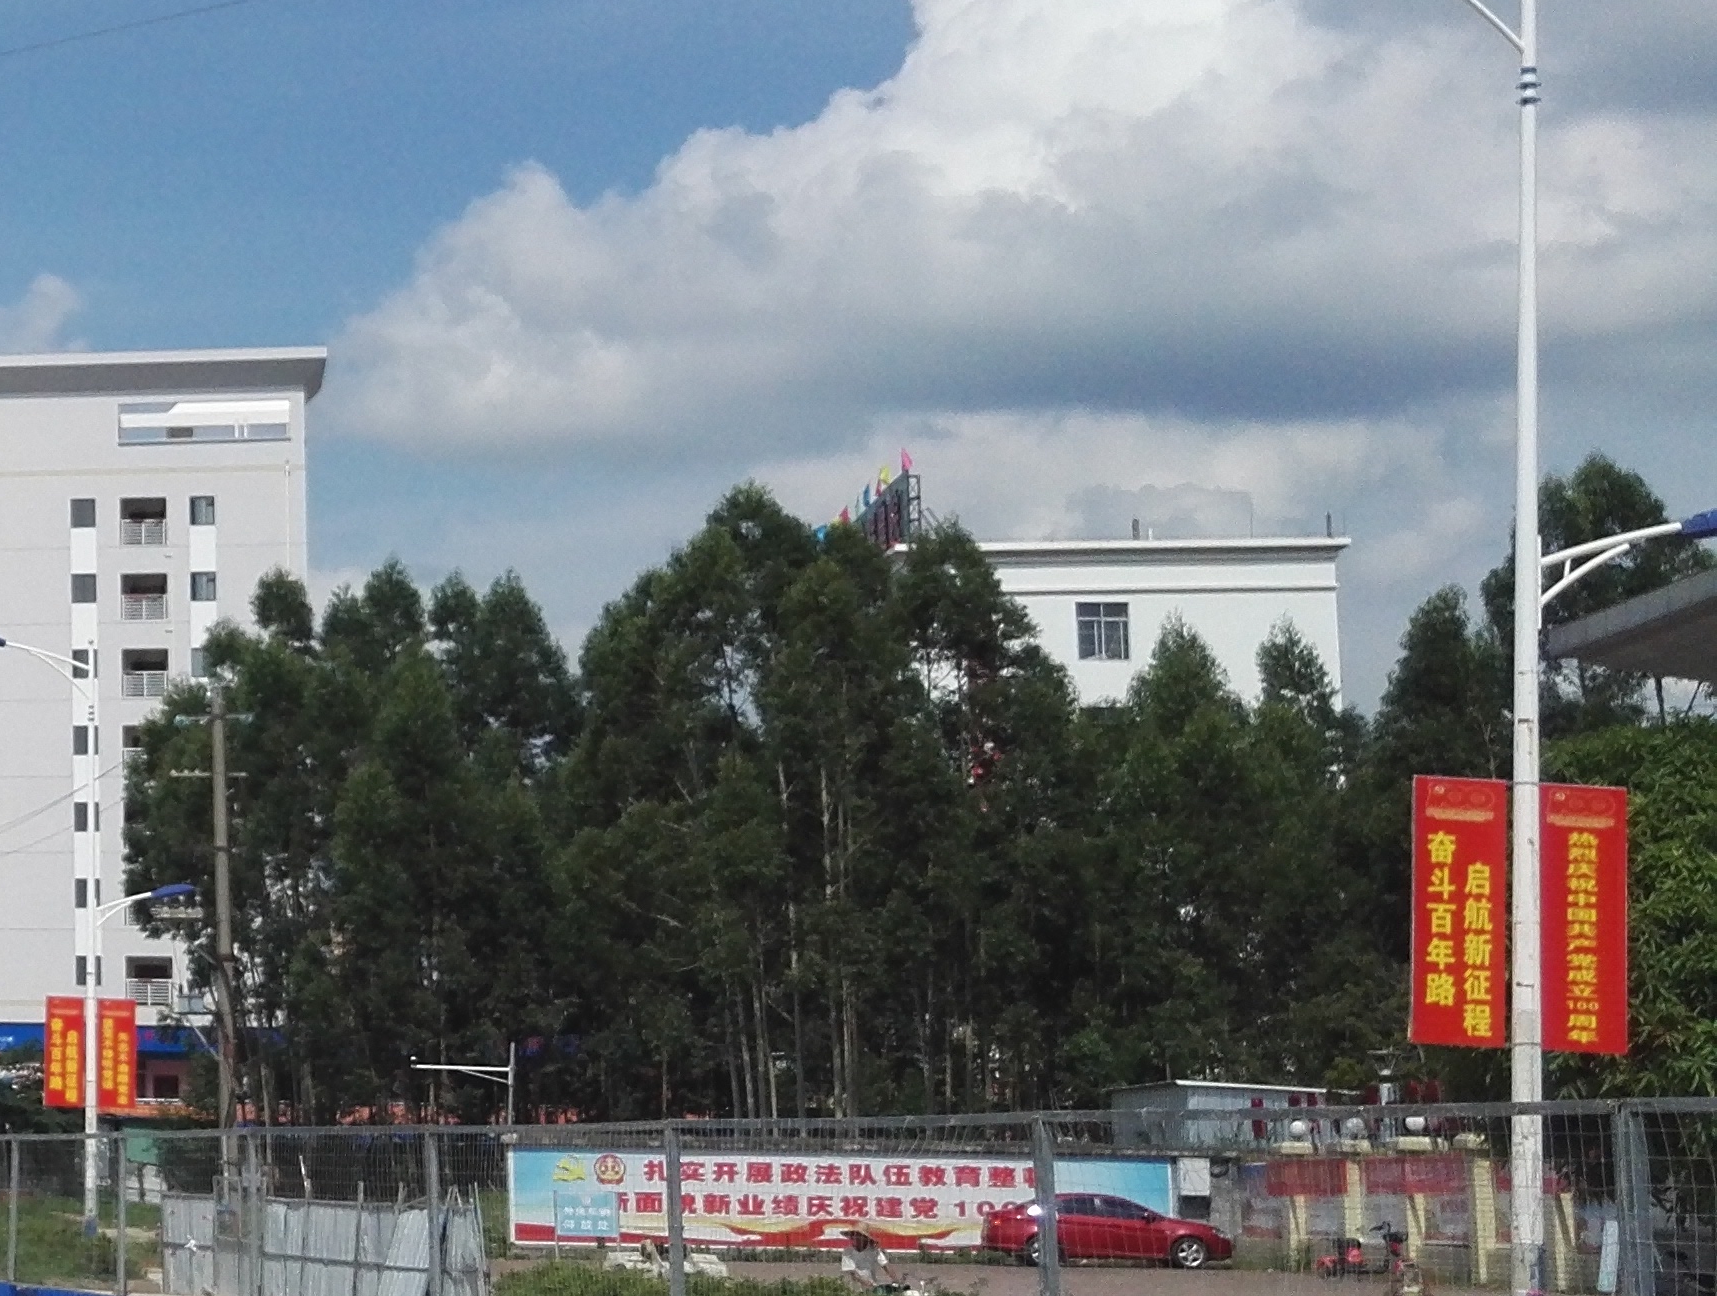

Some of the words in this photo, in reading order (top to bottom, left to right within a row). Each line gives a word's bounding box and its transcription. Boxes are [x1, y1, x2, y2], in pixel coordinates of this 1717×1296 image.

[1425, 830, 1457, 1007] 奋斗百年路
[1463, 860, 1493, 1038] 启航新征程
[1567, 831, 1599, 1044] 热烈庆祝中国共产党成立100周年
